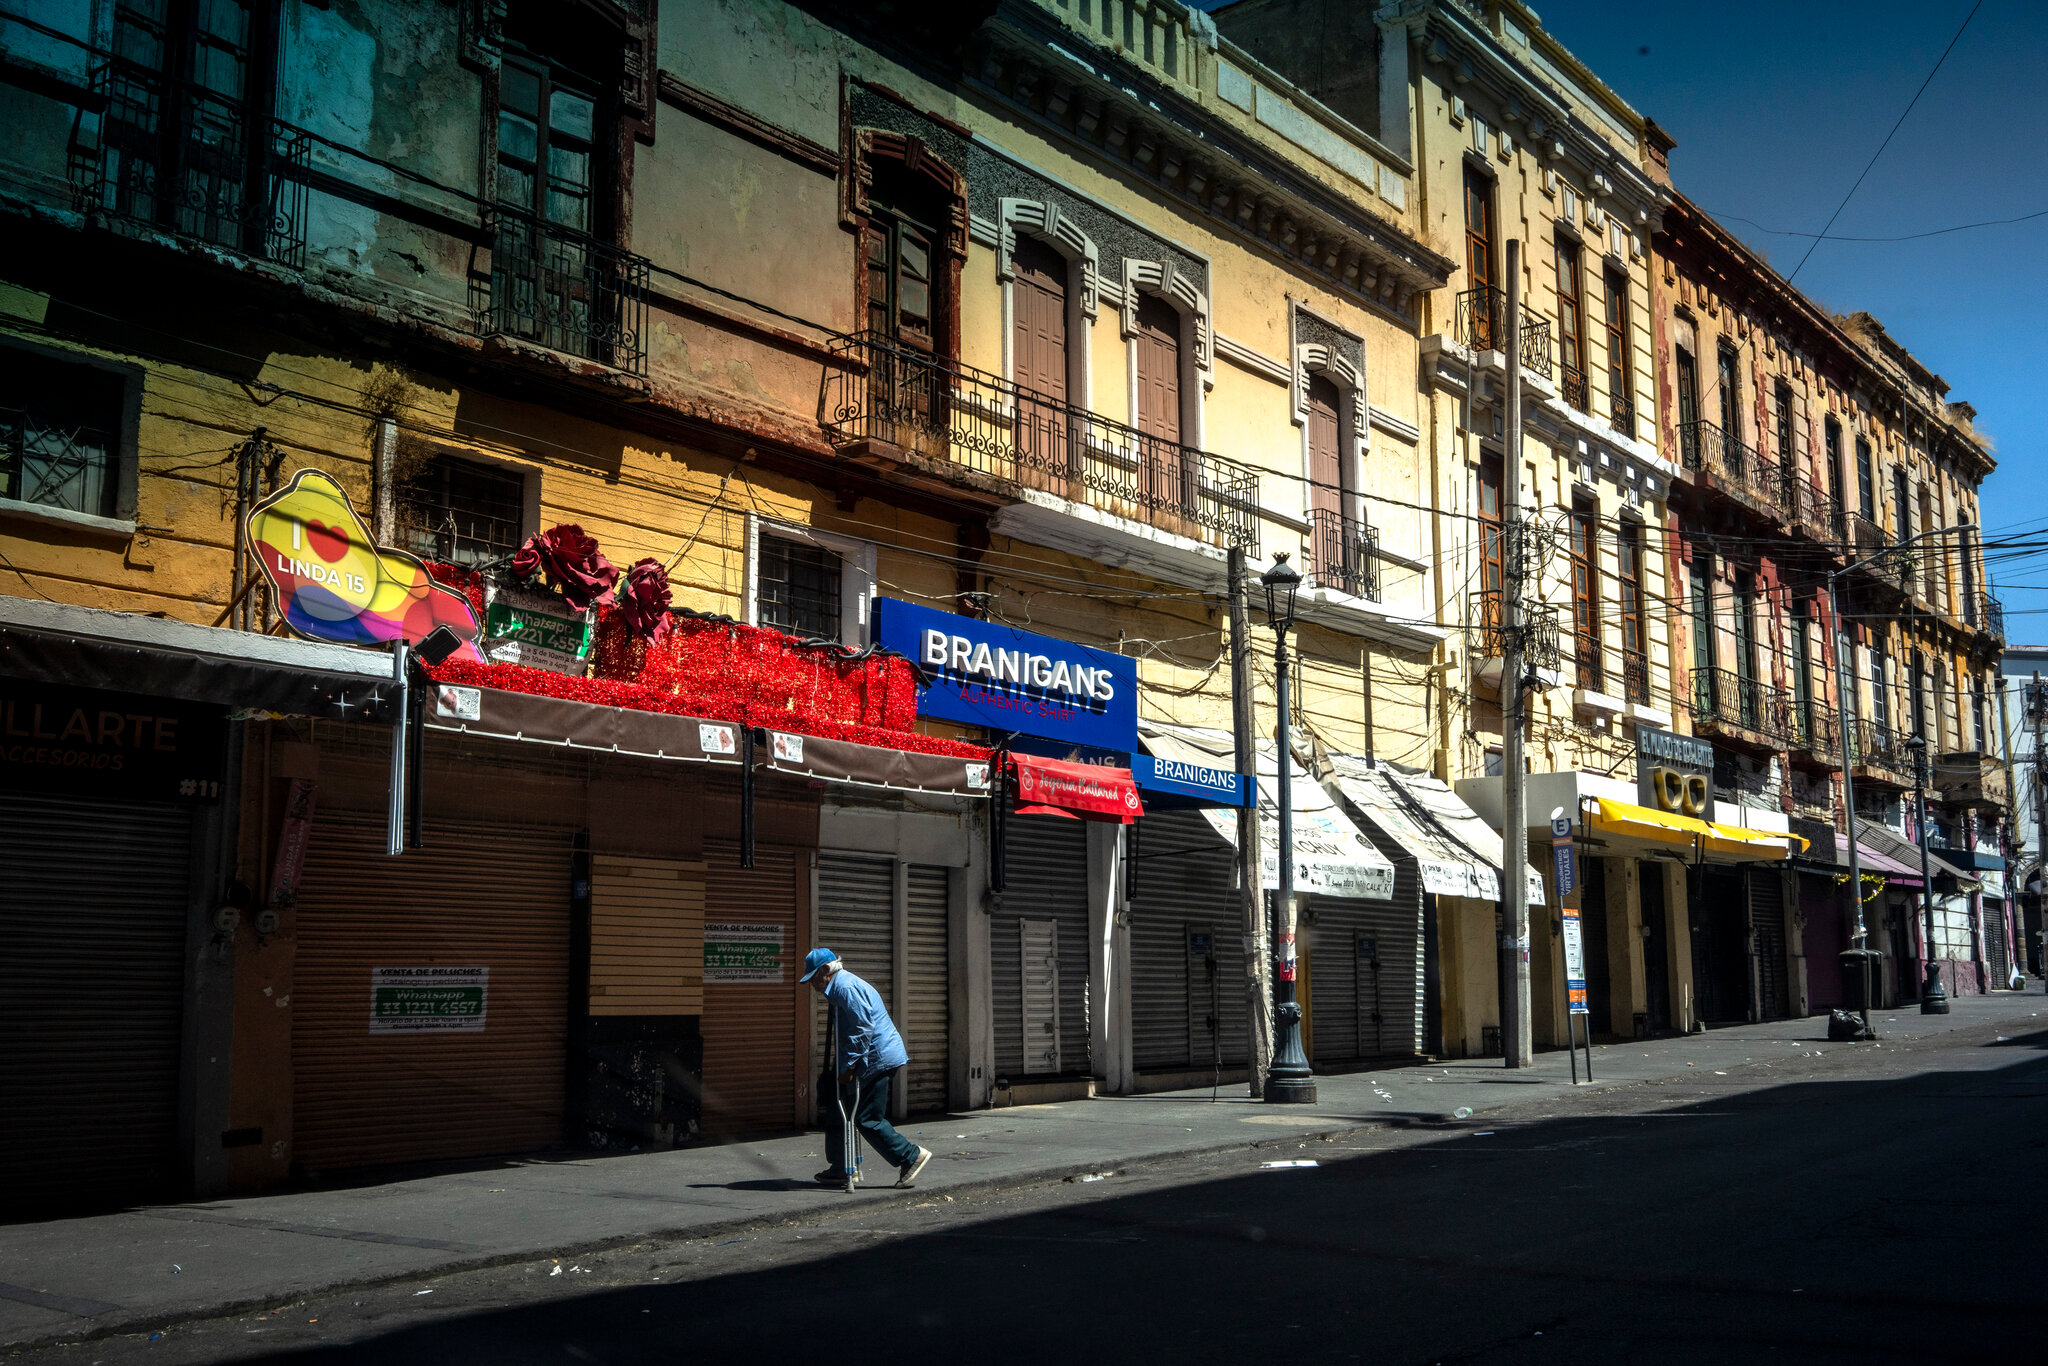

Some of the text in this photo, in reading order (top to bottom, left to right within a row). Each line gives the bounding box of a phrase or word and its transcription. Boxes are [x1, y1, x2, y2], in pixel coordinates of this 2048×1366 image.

[292, 518, 301, 551] I
[277, 553, 365, 593] LINDA 15
[509, 609, 575, 634] Whatsapp
[498, 647, 531, 662] Domingo
[531, 656, 549, 666] 10am
[554, 660, 569, 671] 4pm
[921, 628, 1115, 701] BRANIGANS
[1154, 757, 1237, 790] BRANIGANS
[179, 778, 219, 798] #11
[1556, 819, 1566, 833] E
[1298, 840, 1346, 856] CHUY
[1563, 843, 1572, 895] VIRTUALES
[742, 925, 780, 933] PELUCHES
[716, 943, 769, 955] Whatsapp
[706, 955, 776, 967] 33 1221 4557
[380, 967, 483, 977] VENTA DE PELUCHES
[395, 989, 466, 1001] Whatsapp
[382, 1001, 478, 1015] 33 1221 4557
